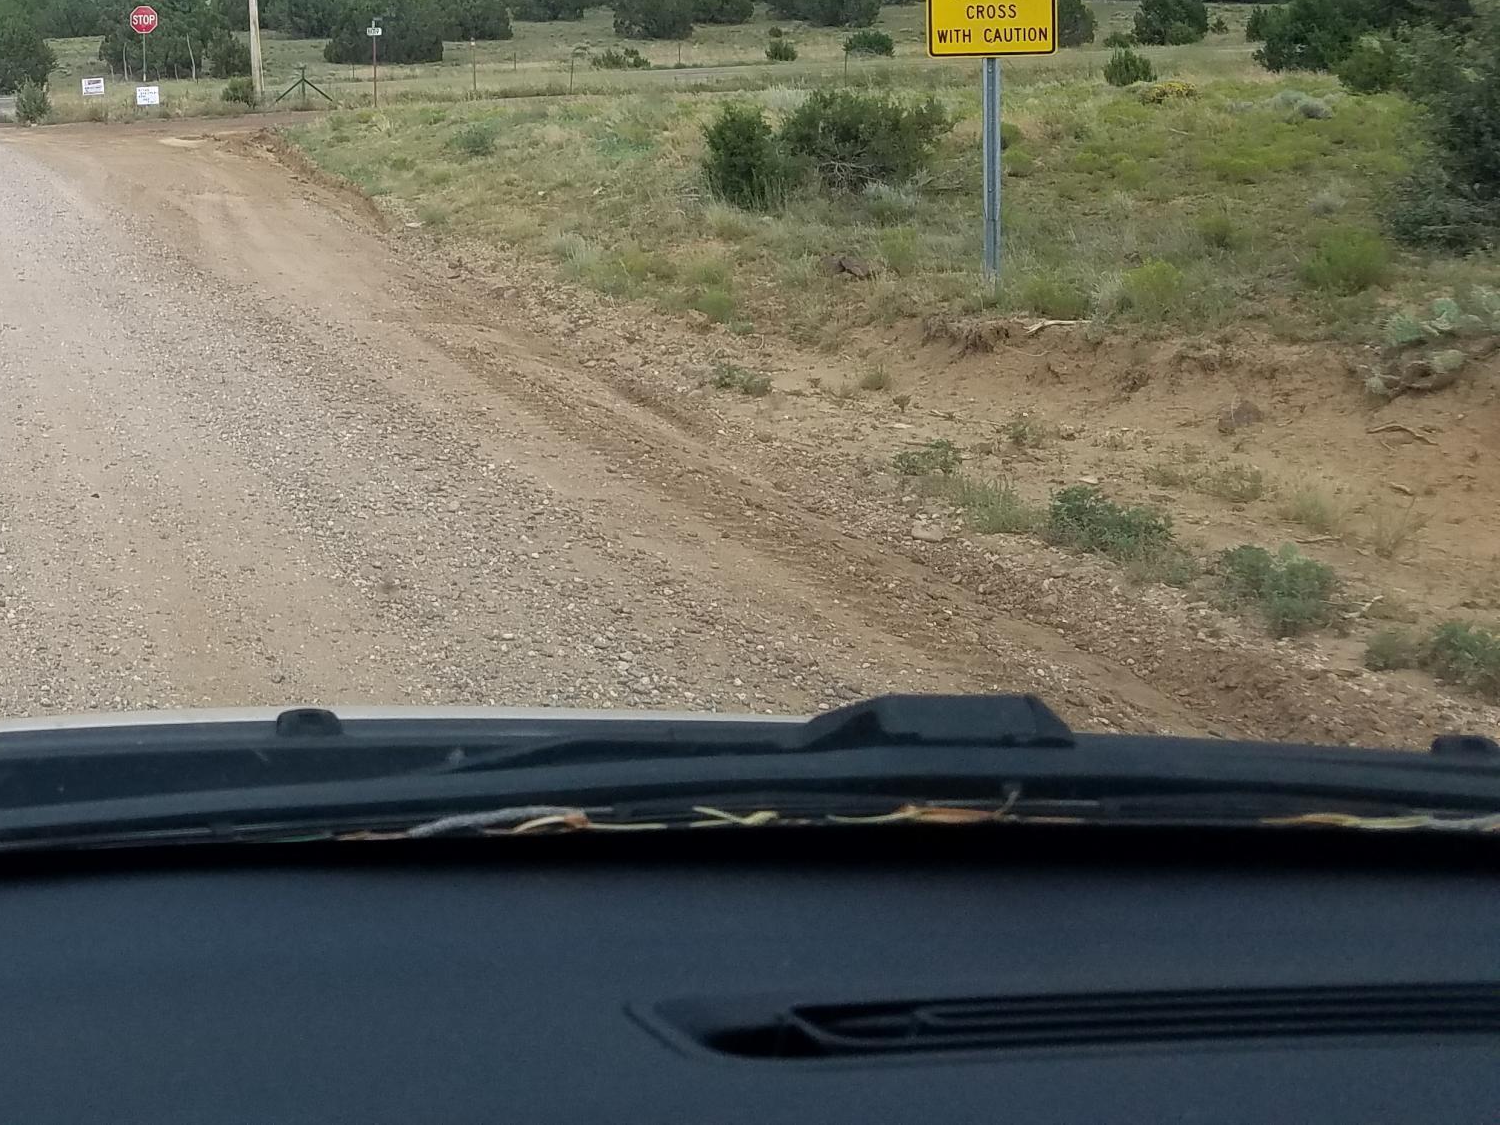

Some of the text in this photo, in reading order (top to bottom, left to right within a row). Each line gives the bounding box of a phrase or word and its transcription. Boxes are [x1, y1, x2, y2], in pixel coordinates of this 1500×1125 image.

[966, 4, 1017, 19] CROSS
[132, 14, 156, 25] STOP
[937, 27, 1048, 43] WITH CAUTION
